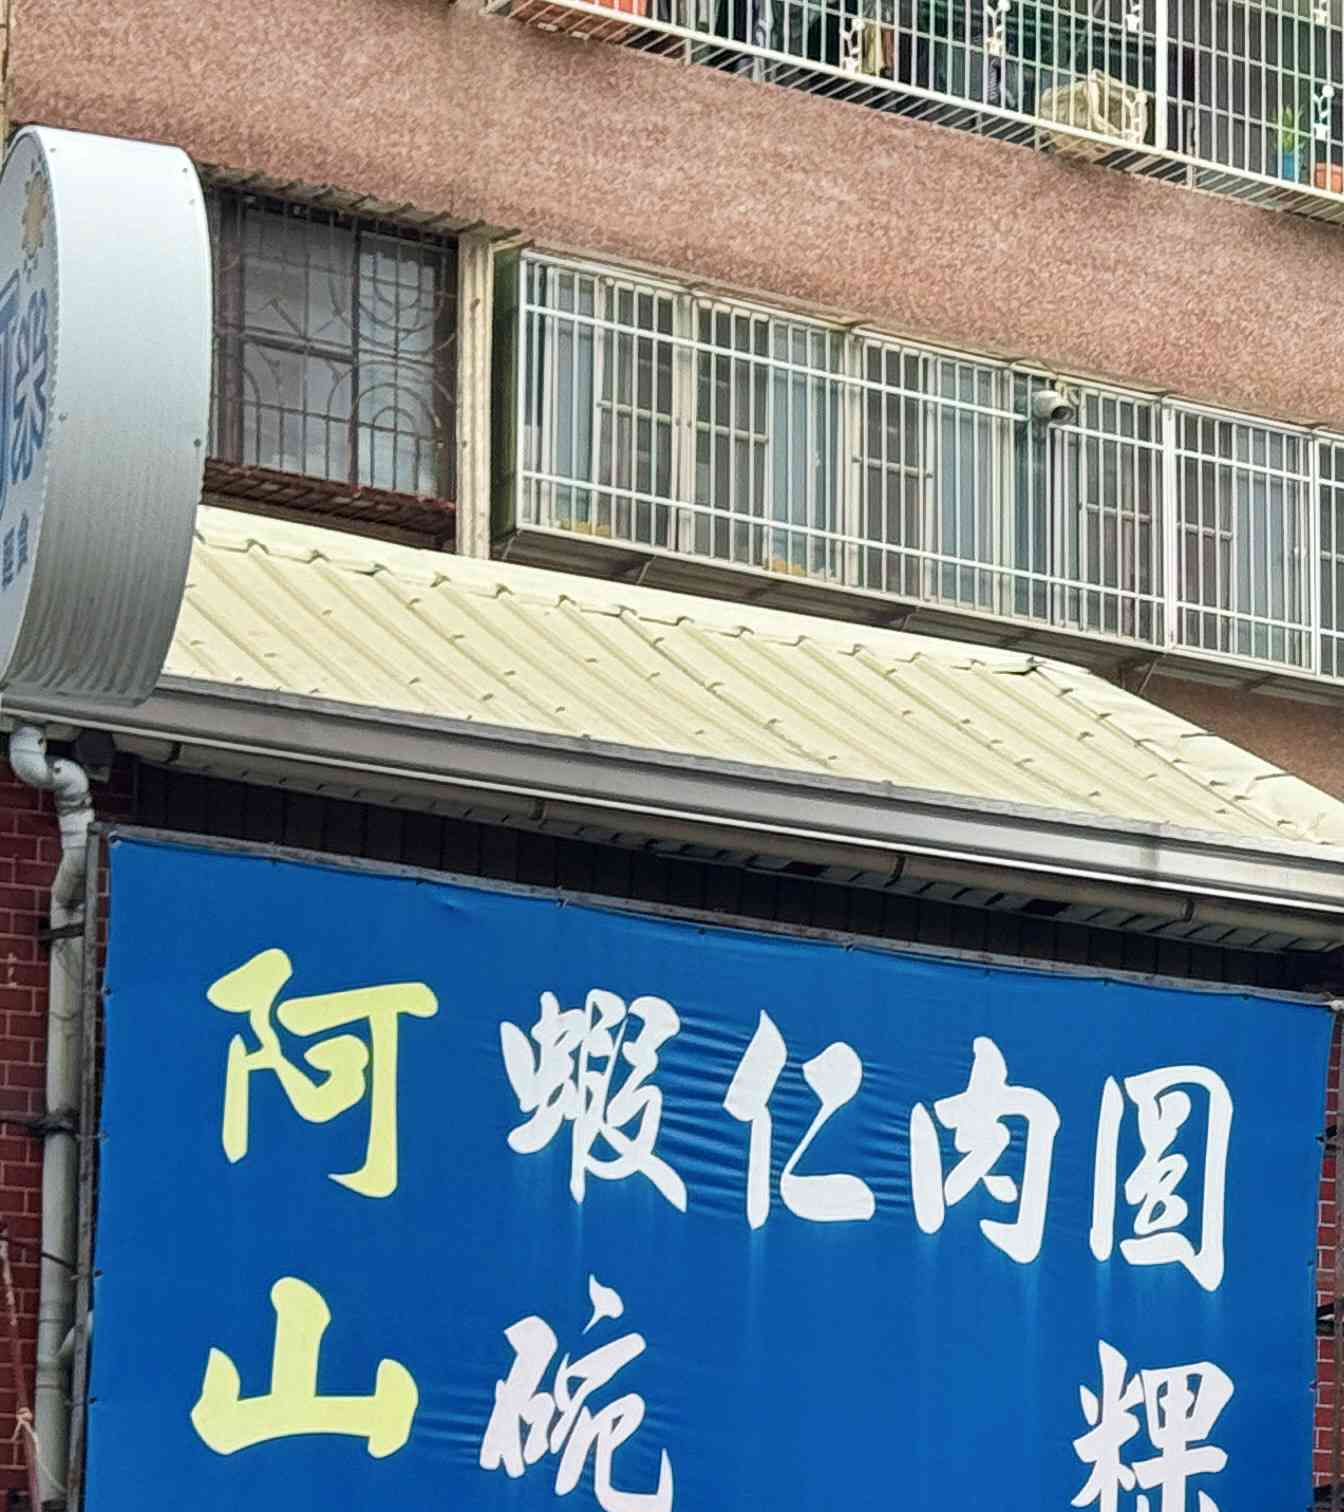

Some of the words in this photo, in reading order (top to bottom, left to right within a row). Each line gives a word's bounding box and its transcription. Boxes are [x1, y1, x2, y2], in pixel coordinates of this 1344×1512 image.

[191, 947, 439, 1460] 阿山
[500, 988, 1235, 1291] 蝦仁肉圓
